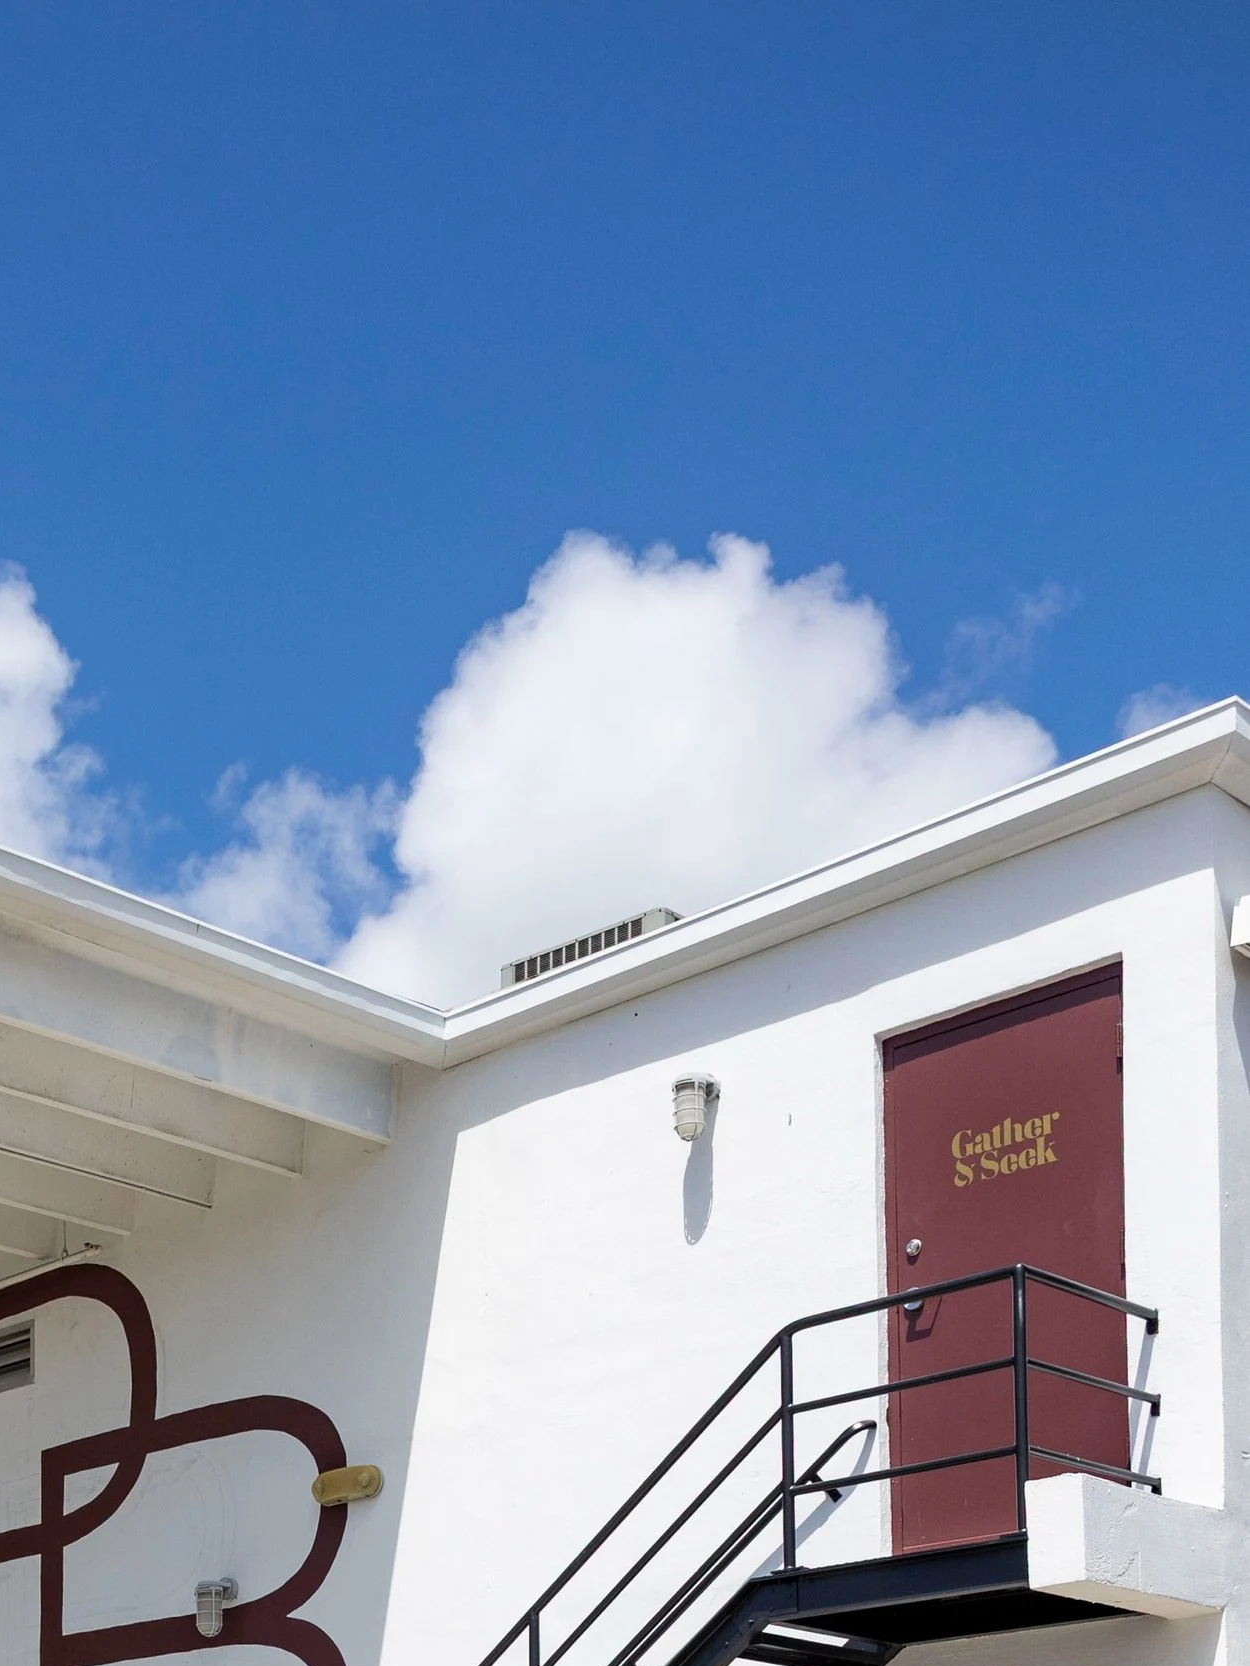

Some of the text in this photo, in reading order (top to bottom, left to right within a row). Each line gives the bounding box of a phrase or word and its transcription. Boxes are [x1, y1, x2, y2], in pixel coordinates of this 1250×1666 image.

[952, 1112, 1060, 1159] Gather
[953, 1137, 1058, 1187] & Seek
